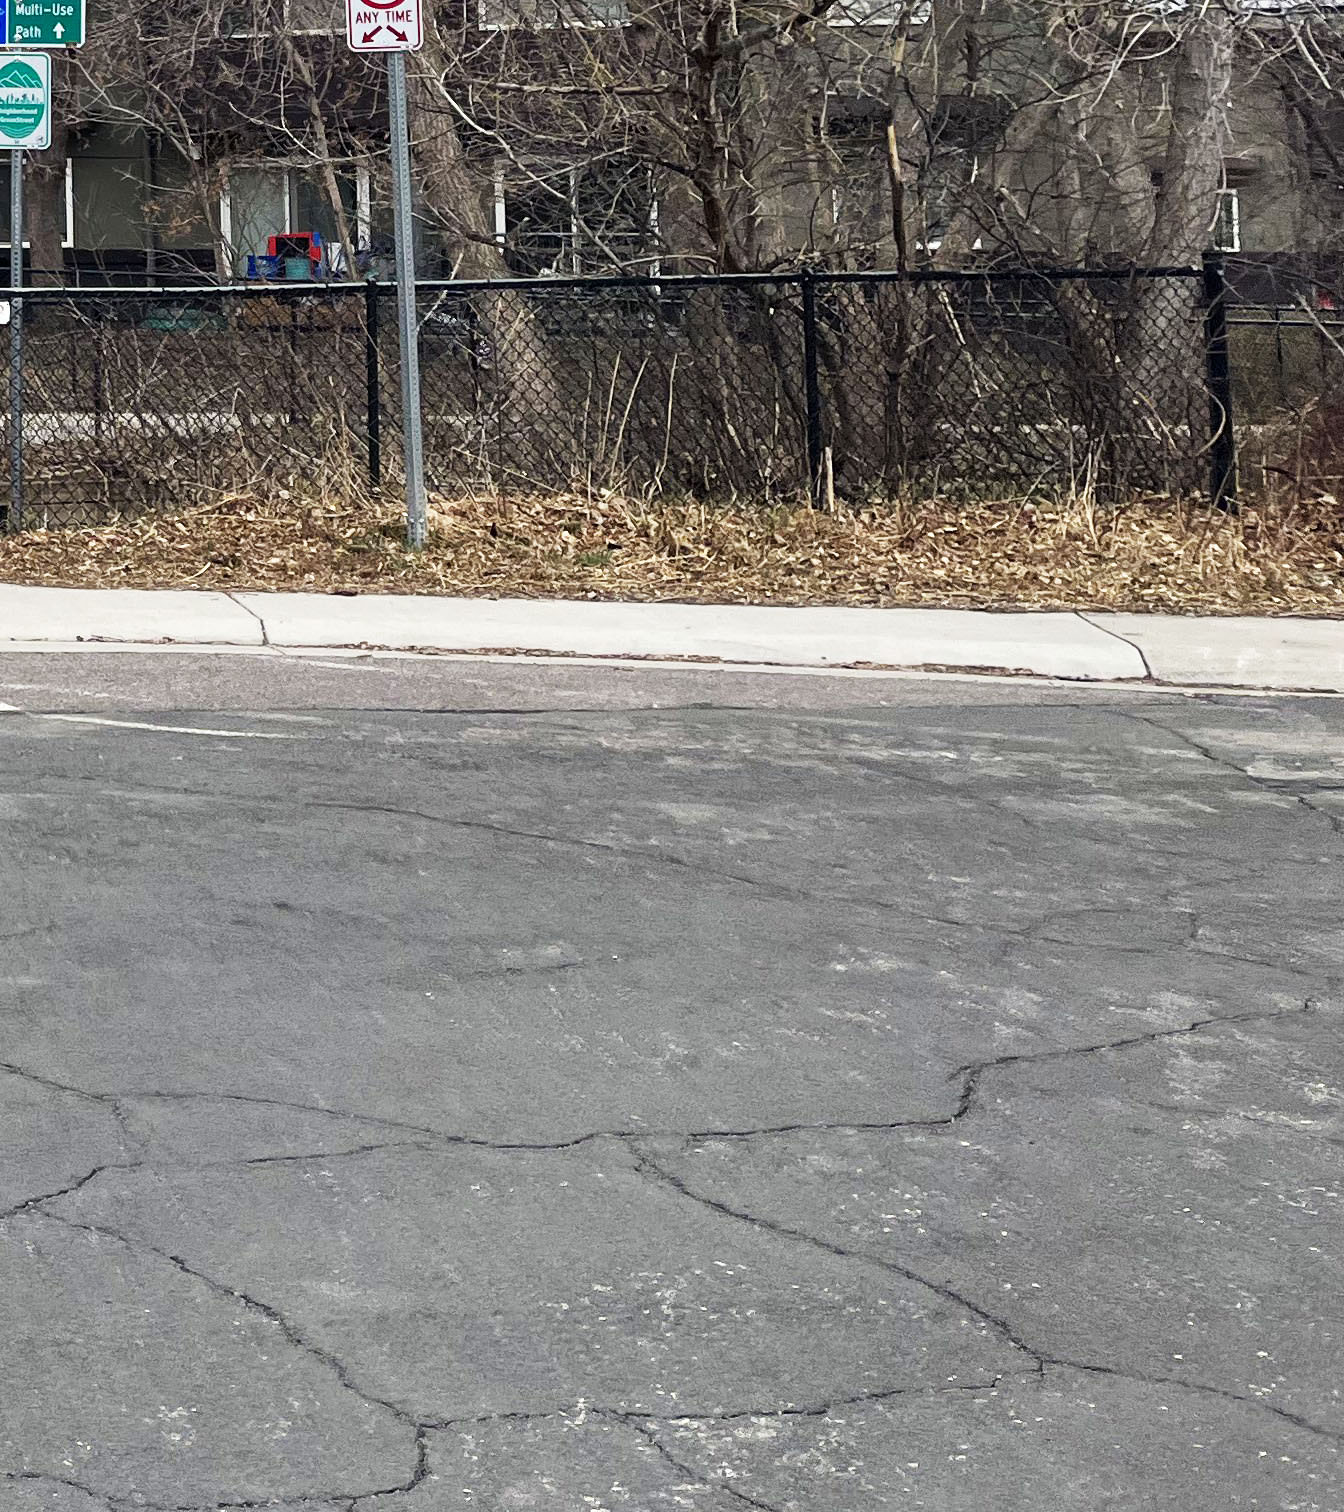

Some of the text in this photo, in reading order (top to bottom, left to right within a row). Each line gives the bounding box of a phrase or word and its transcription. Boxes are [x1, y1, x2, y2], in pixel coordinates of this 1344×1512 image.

[15, 3, 74, 16] Multi-Use
[355, 10, 413, 24] ANY TIME
[15, 25, 41, 38] Path
